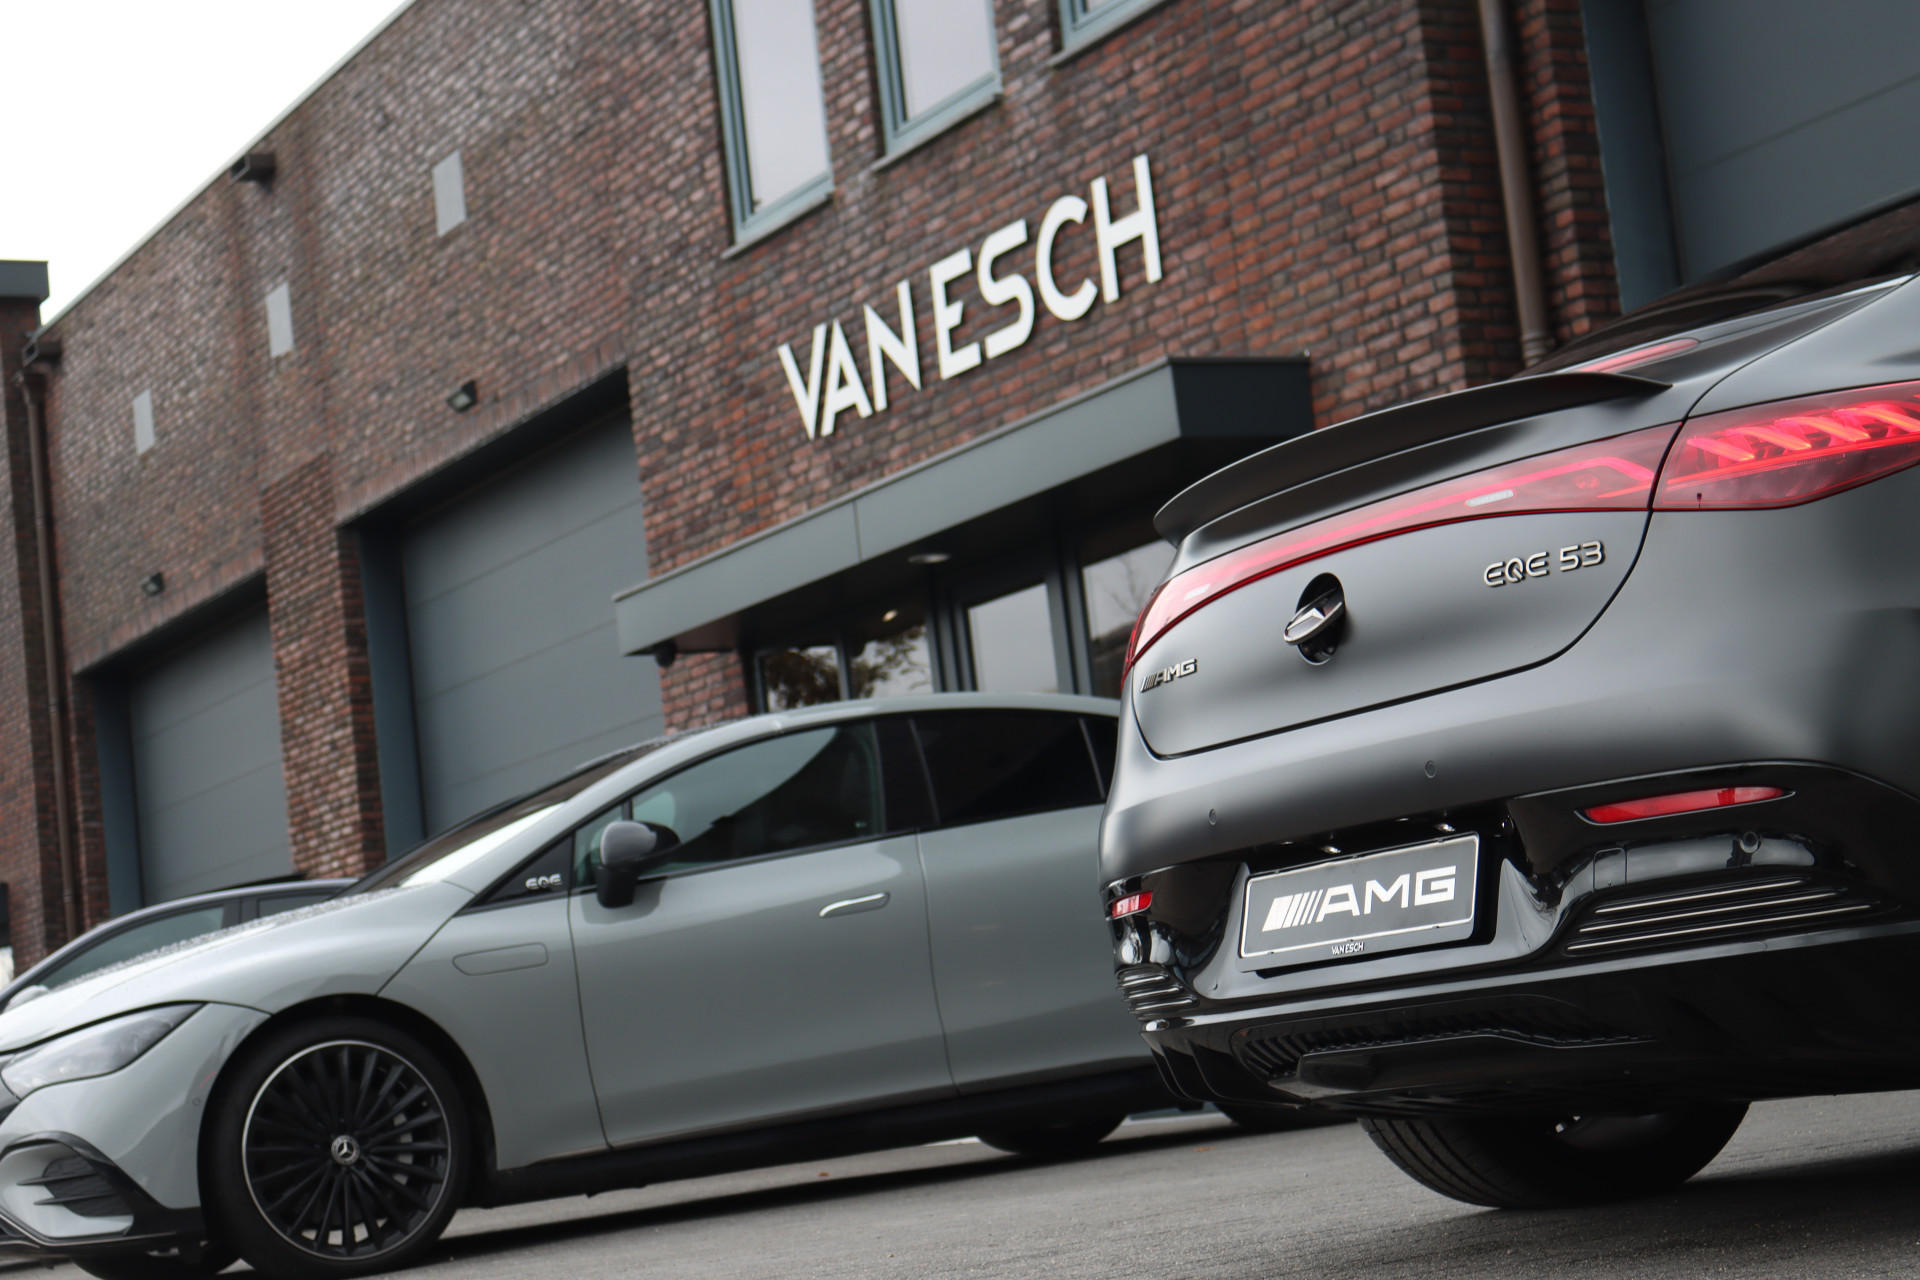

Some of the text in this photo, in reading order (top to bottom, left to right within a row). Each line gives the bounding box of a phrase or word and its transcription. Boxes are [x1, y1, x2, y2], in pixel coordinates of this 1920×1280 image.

[777, 153, 1163, 441] VAN ESCH
[1483, 540, 1605, 587] EQE 53
[1153, 658, 1198, 687] AMG
[525, 873, 563, 890] EQE
[1315, 865, 1457, 923] AMG
